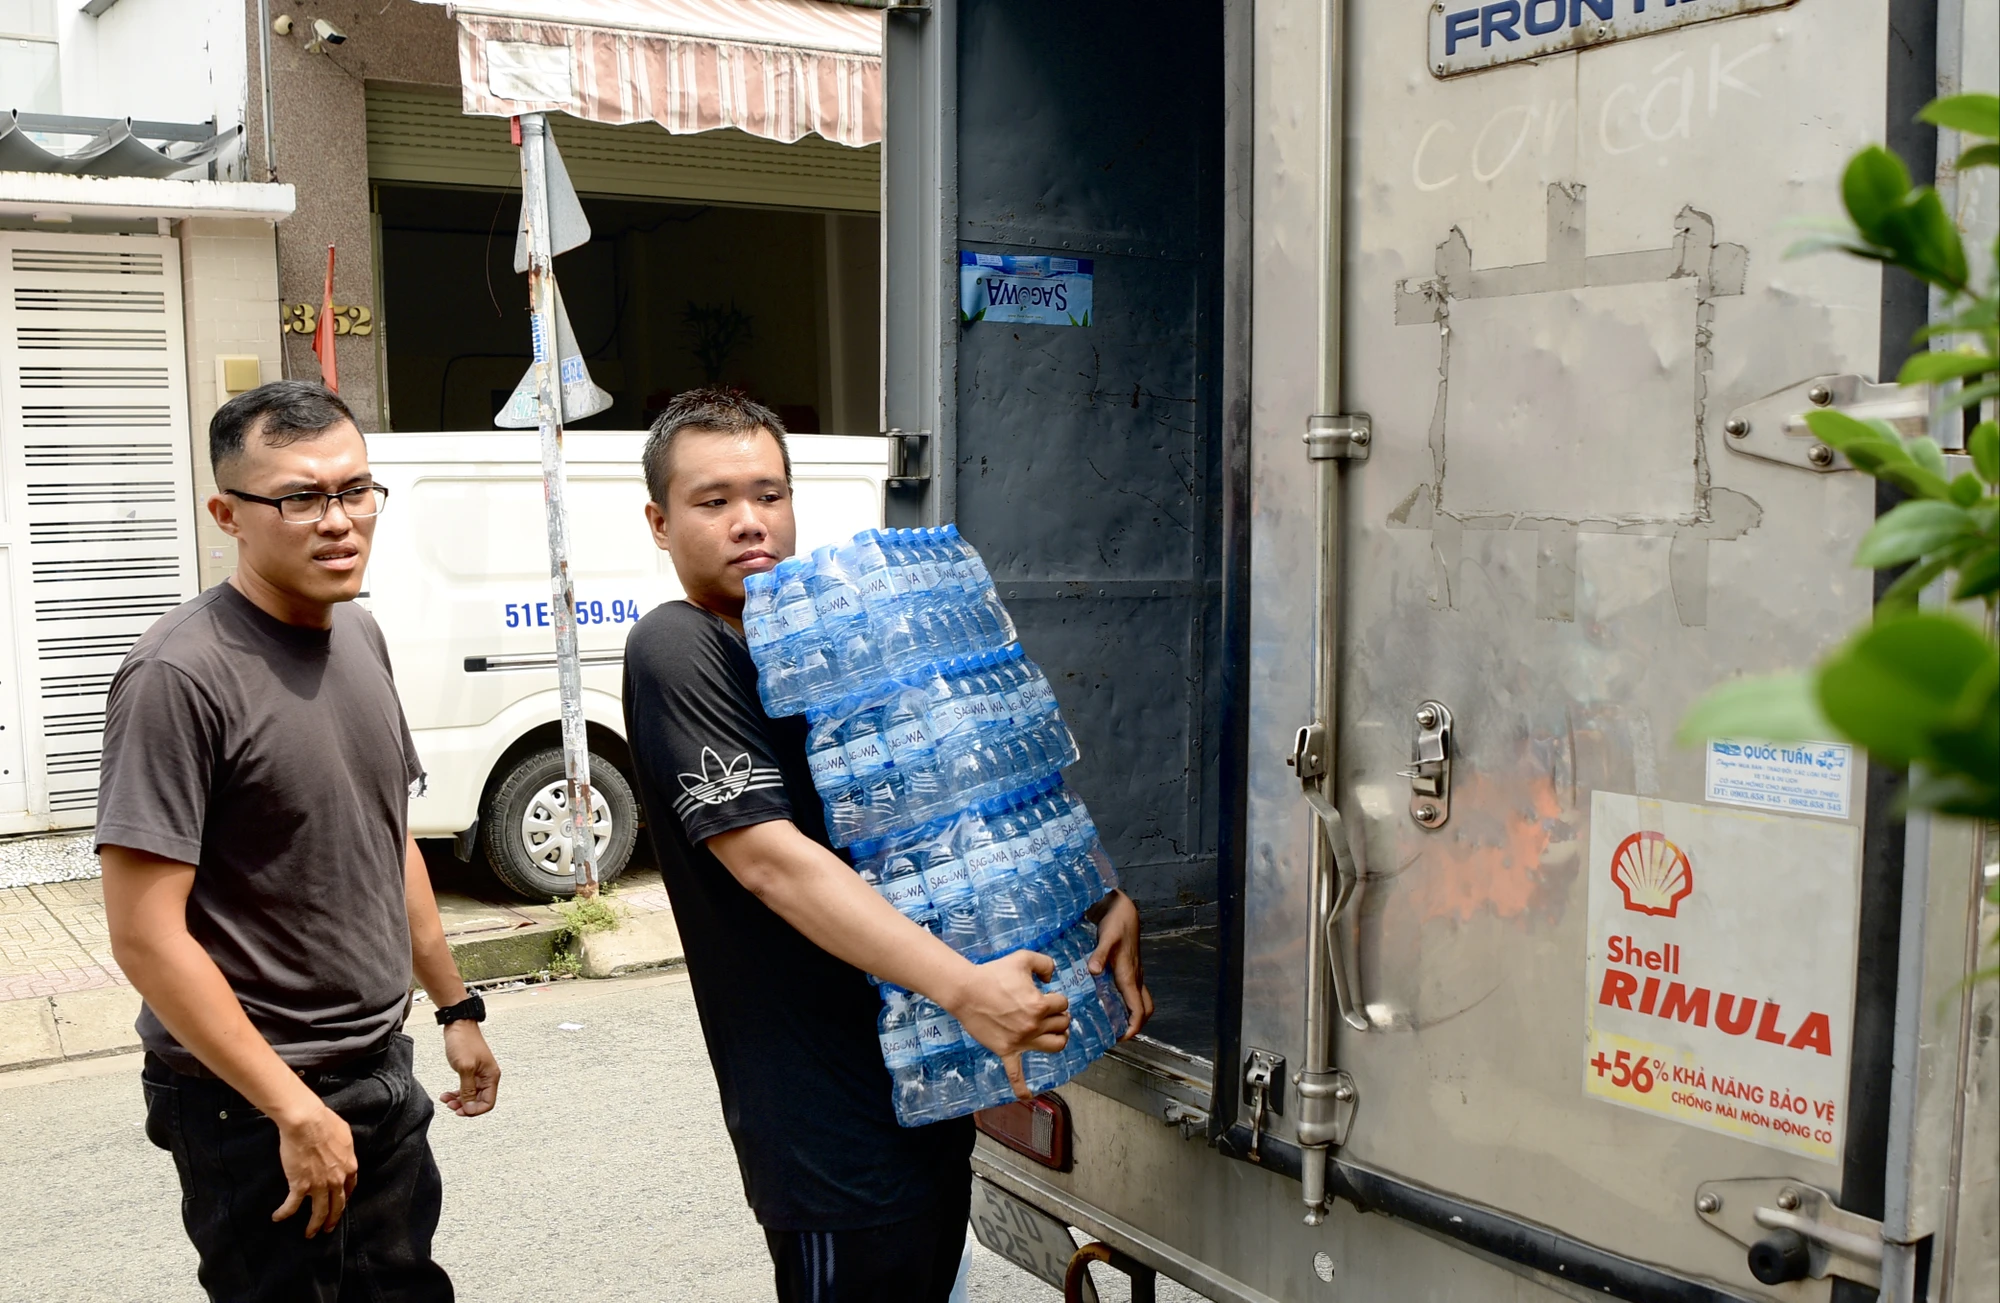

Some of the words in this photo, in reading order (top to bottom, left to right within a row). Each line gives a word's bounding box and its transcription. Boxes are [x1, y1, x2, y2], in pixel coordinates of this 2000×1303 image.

[1743, 742, 1778, 761] QUỐC
[1781, 747, 1813, 766] TUẤN
[1607, 935, 1679, 975] Shell
[1599, 968, 1833, 1057] RIMULA
[1671, 1091, 1712, 1113] CHỐNG
[1715, 1101, 1737, 1119] MÀI
[1740, 1109, 1770, 1129] MÒN
[1773, 1118, 1810, 1138] ĐỘNG
[1814, 1128, 1833, 1144] CƠ
[1673, 1065, 1707, 1091] KHẢ
[1712, 1075, 1764, 1104] NĂNG
[1769, 1088, 1808, 1115] BẢO
[1813, 1100, 1836, 1126] VỆ
[982, 1186, 1043, 1243] 51D
